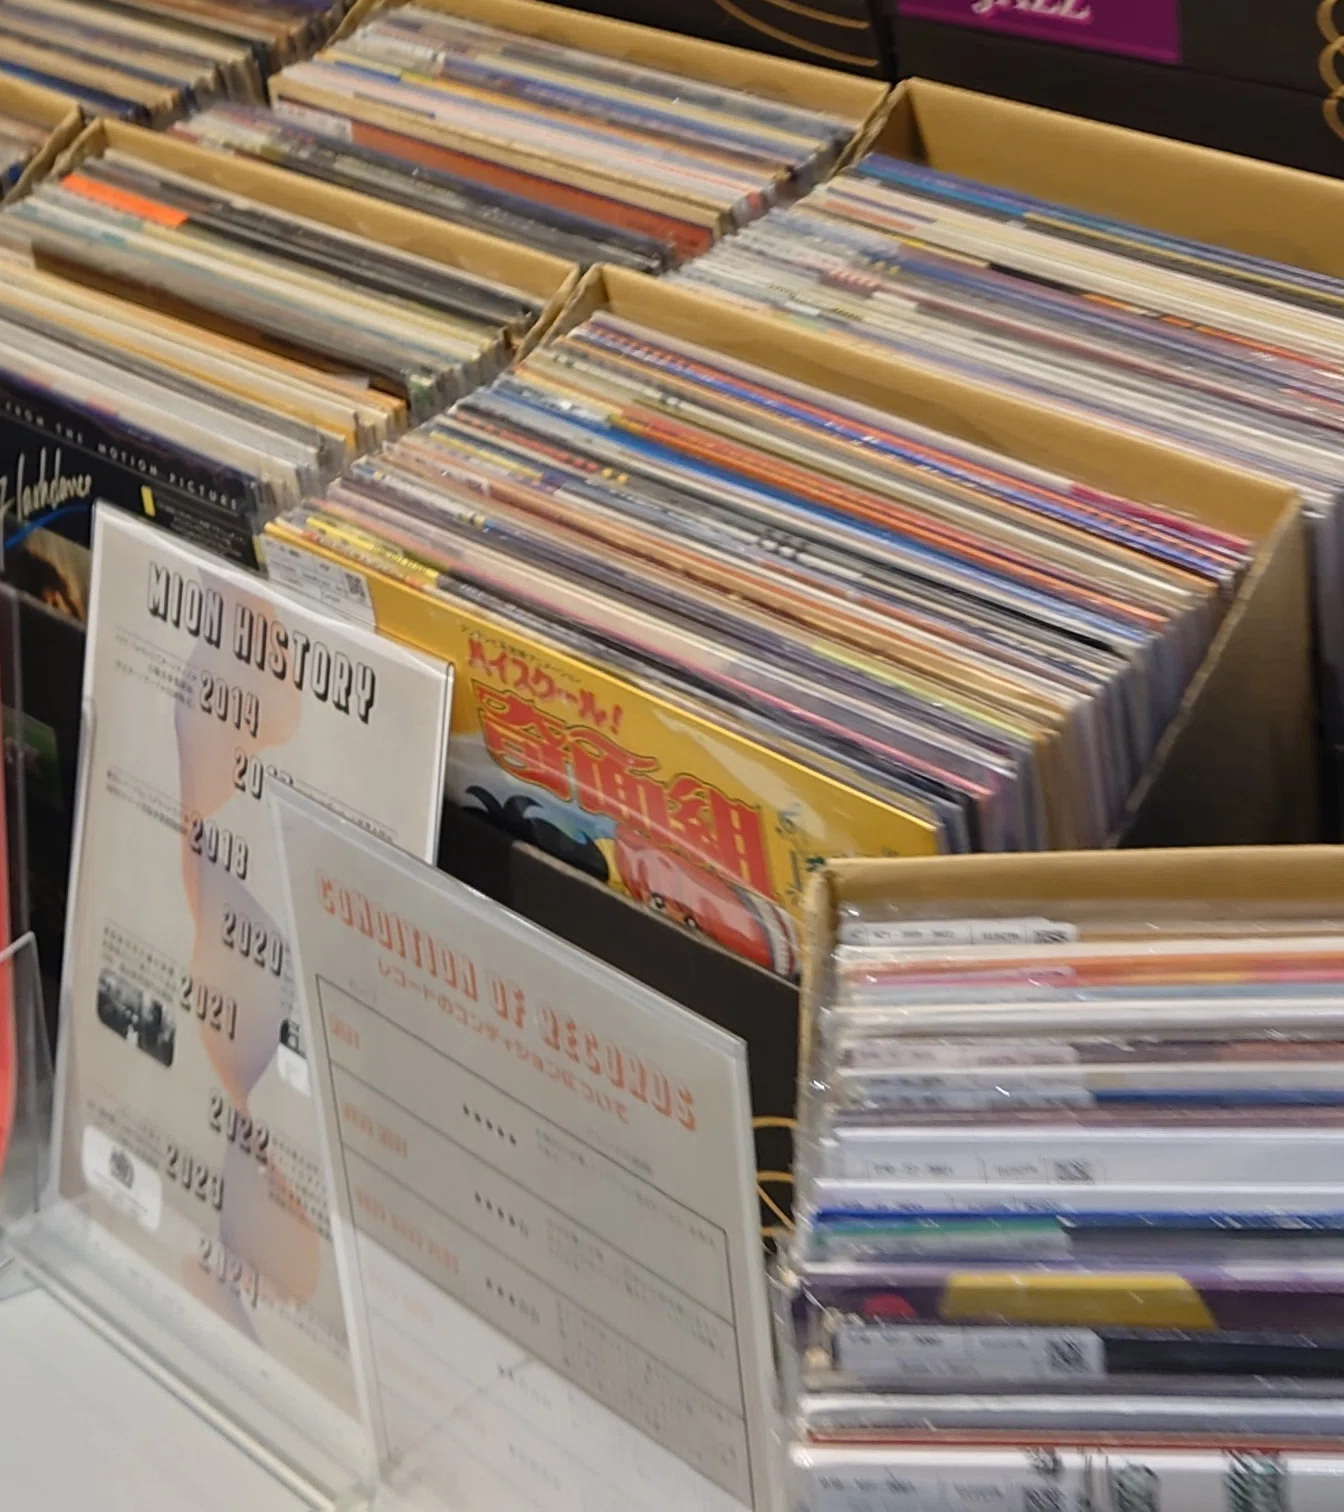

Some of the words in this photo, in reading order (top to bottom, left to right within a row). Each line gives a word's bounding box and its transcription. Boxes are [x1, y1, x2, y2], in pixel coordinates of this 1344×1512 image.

[97, 441, 158, 476] MOTION
[146, 561, 225, 649] MION
[232, 601, 379, 725] HISTORY
[198, 671, 261, 740] 2014
[188, 810, 250, 881] 2018
[220, 902, 286, 978] 2020
[178, 973, 239, 1042] 2021
[314, 871, 479, 1004] CONDITION
[487, 972, 527, 1030] OF
[536, 1000, 697, 1134] RECORDS
[209, 1093, 271, 1166] 2022
